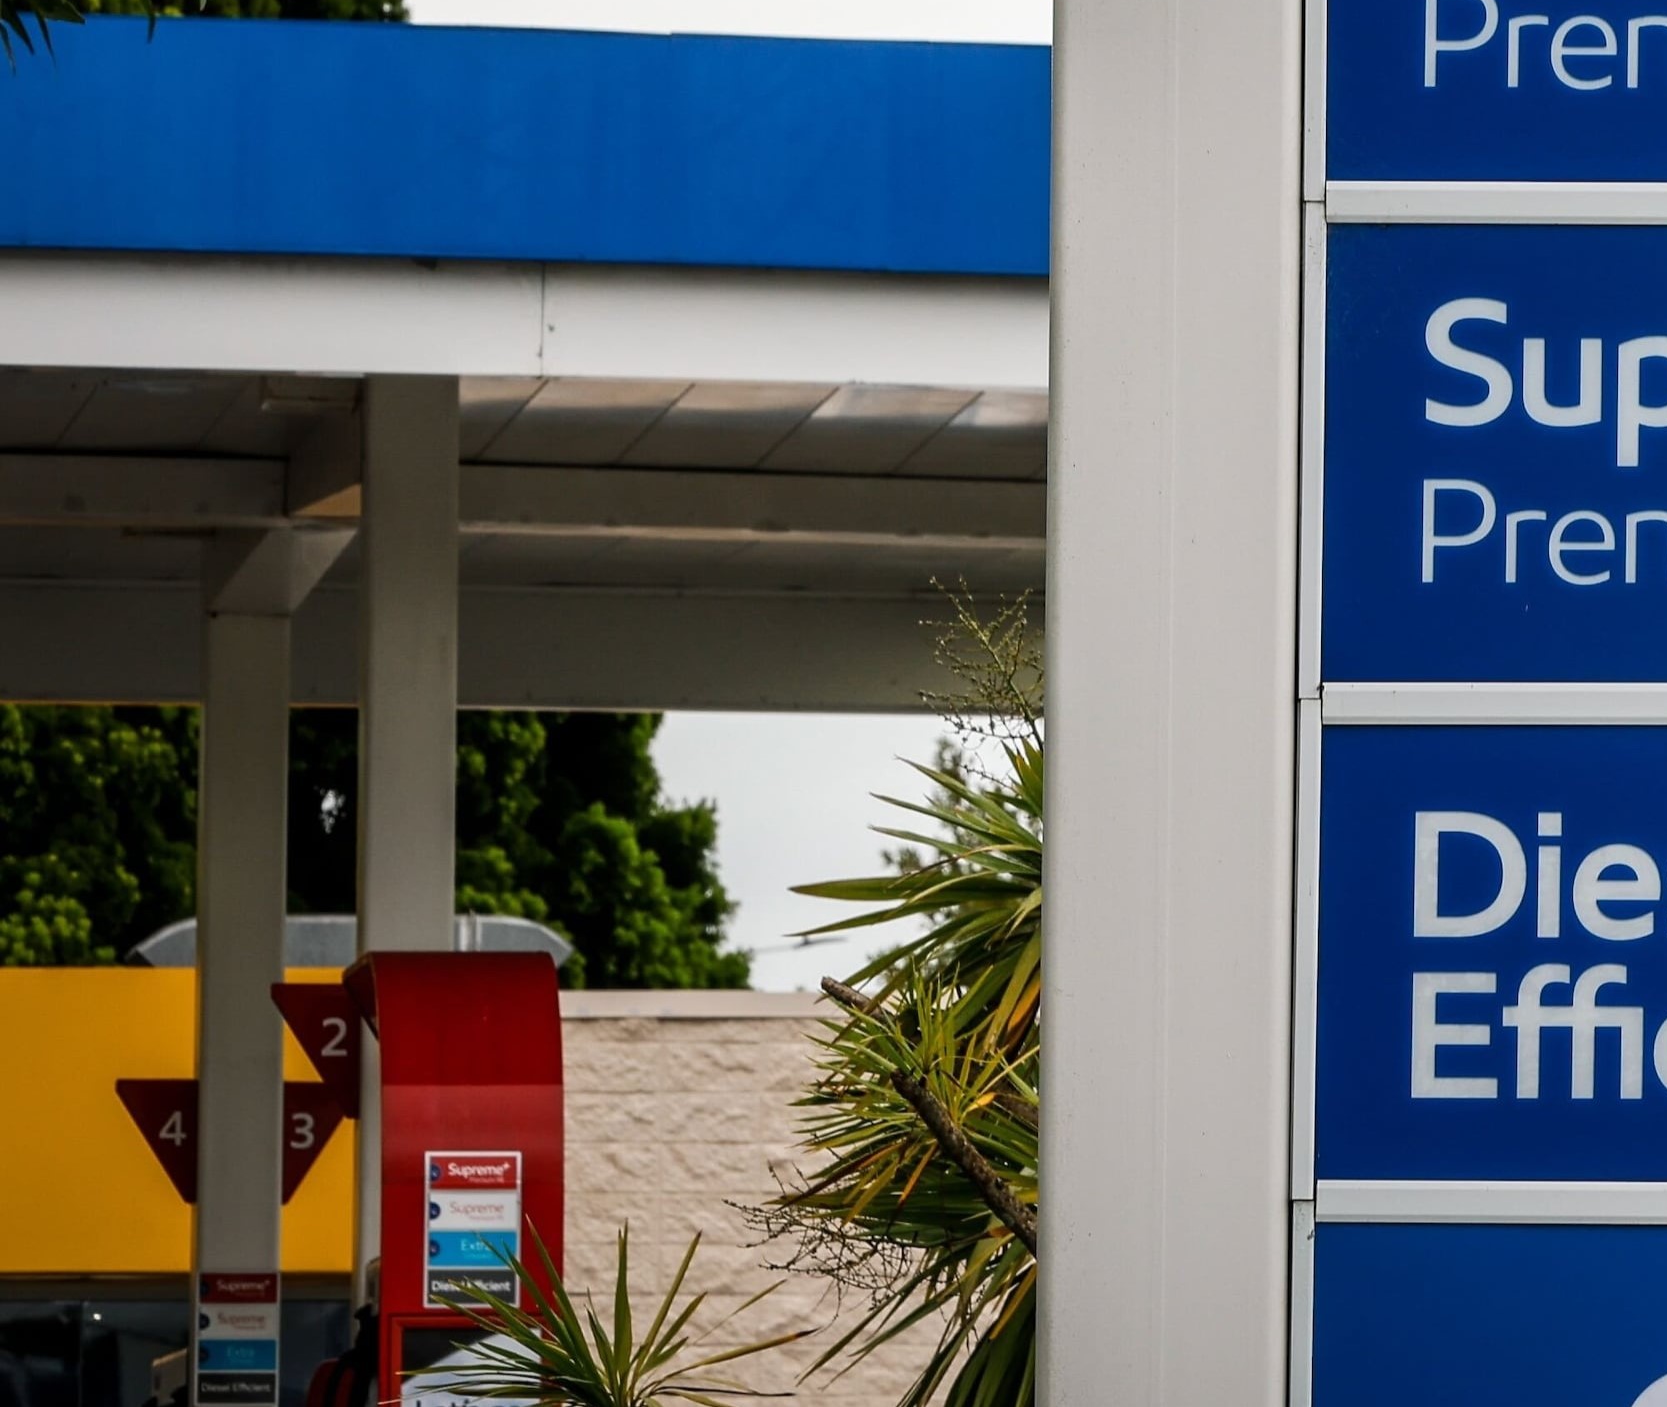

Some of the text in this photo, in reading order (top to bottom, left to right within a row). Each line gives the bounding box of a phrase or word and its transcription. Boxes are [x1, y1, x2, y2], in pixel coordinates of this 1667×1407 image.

[320, 1017, 348, 1057] 2
[158, 1110, 188, 1146] 4
[289, 1112, 315, 1150] 3
[449, 1201, 505, 1215] Supreme
[431, 1279, 465, 1292] Diesl
